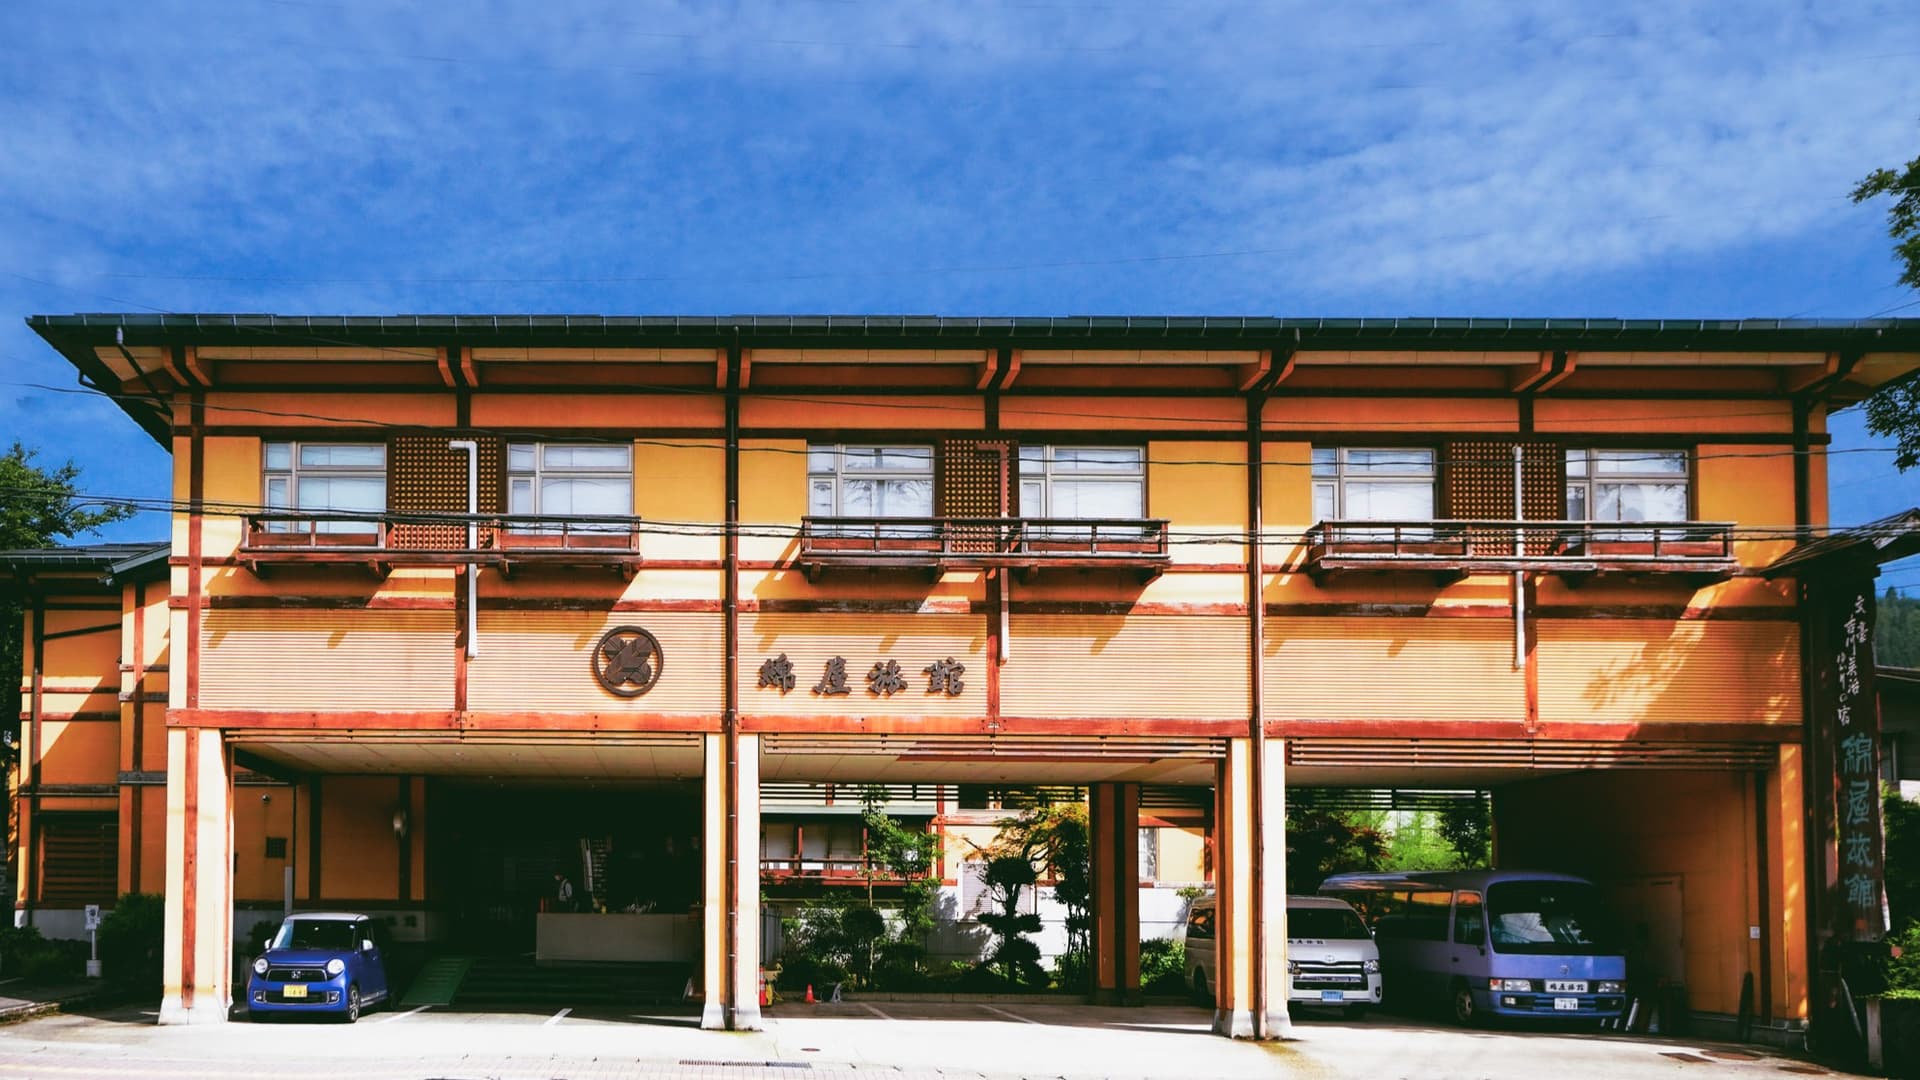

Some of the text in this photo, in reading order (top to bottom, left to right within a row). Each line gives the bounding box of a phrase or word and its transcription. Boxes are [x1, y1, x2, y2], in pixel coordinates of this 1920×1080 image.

[1854, 594, 1869, 643] 文豪
[758, 653, 966, 696] 綿屋旅館
[1843, 613, 1861, 696] 吉川英治
[1841, 733, 1877, 909] 綿屋旅館
